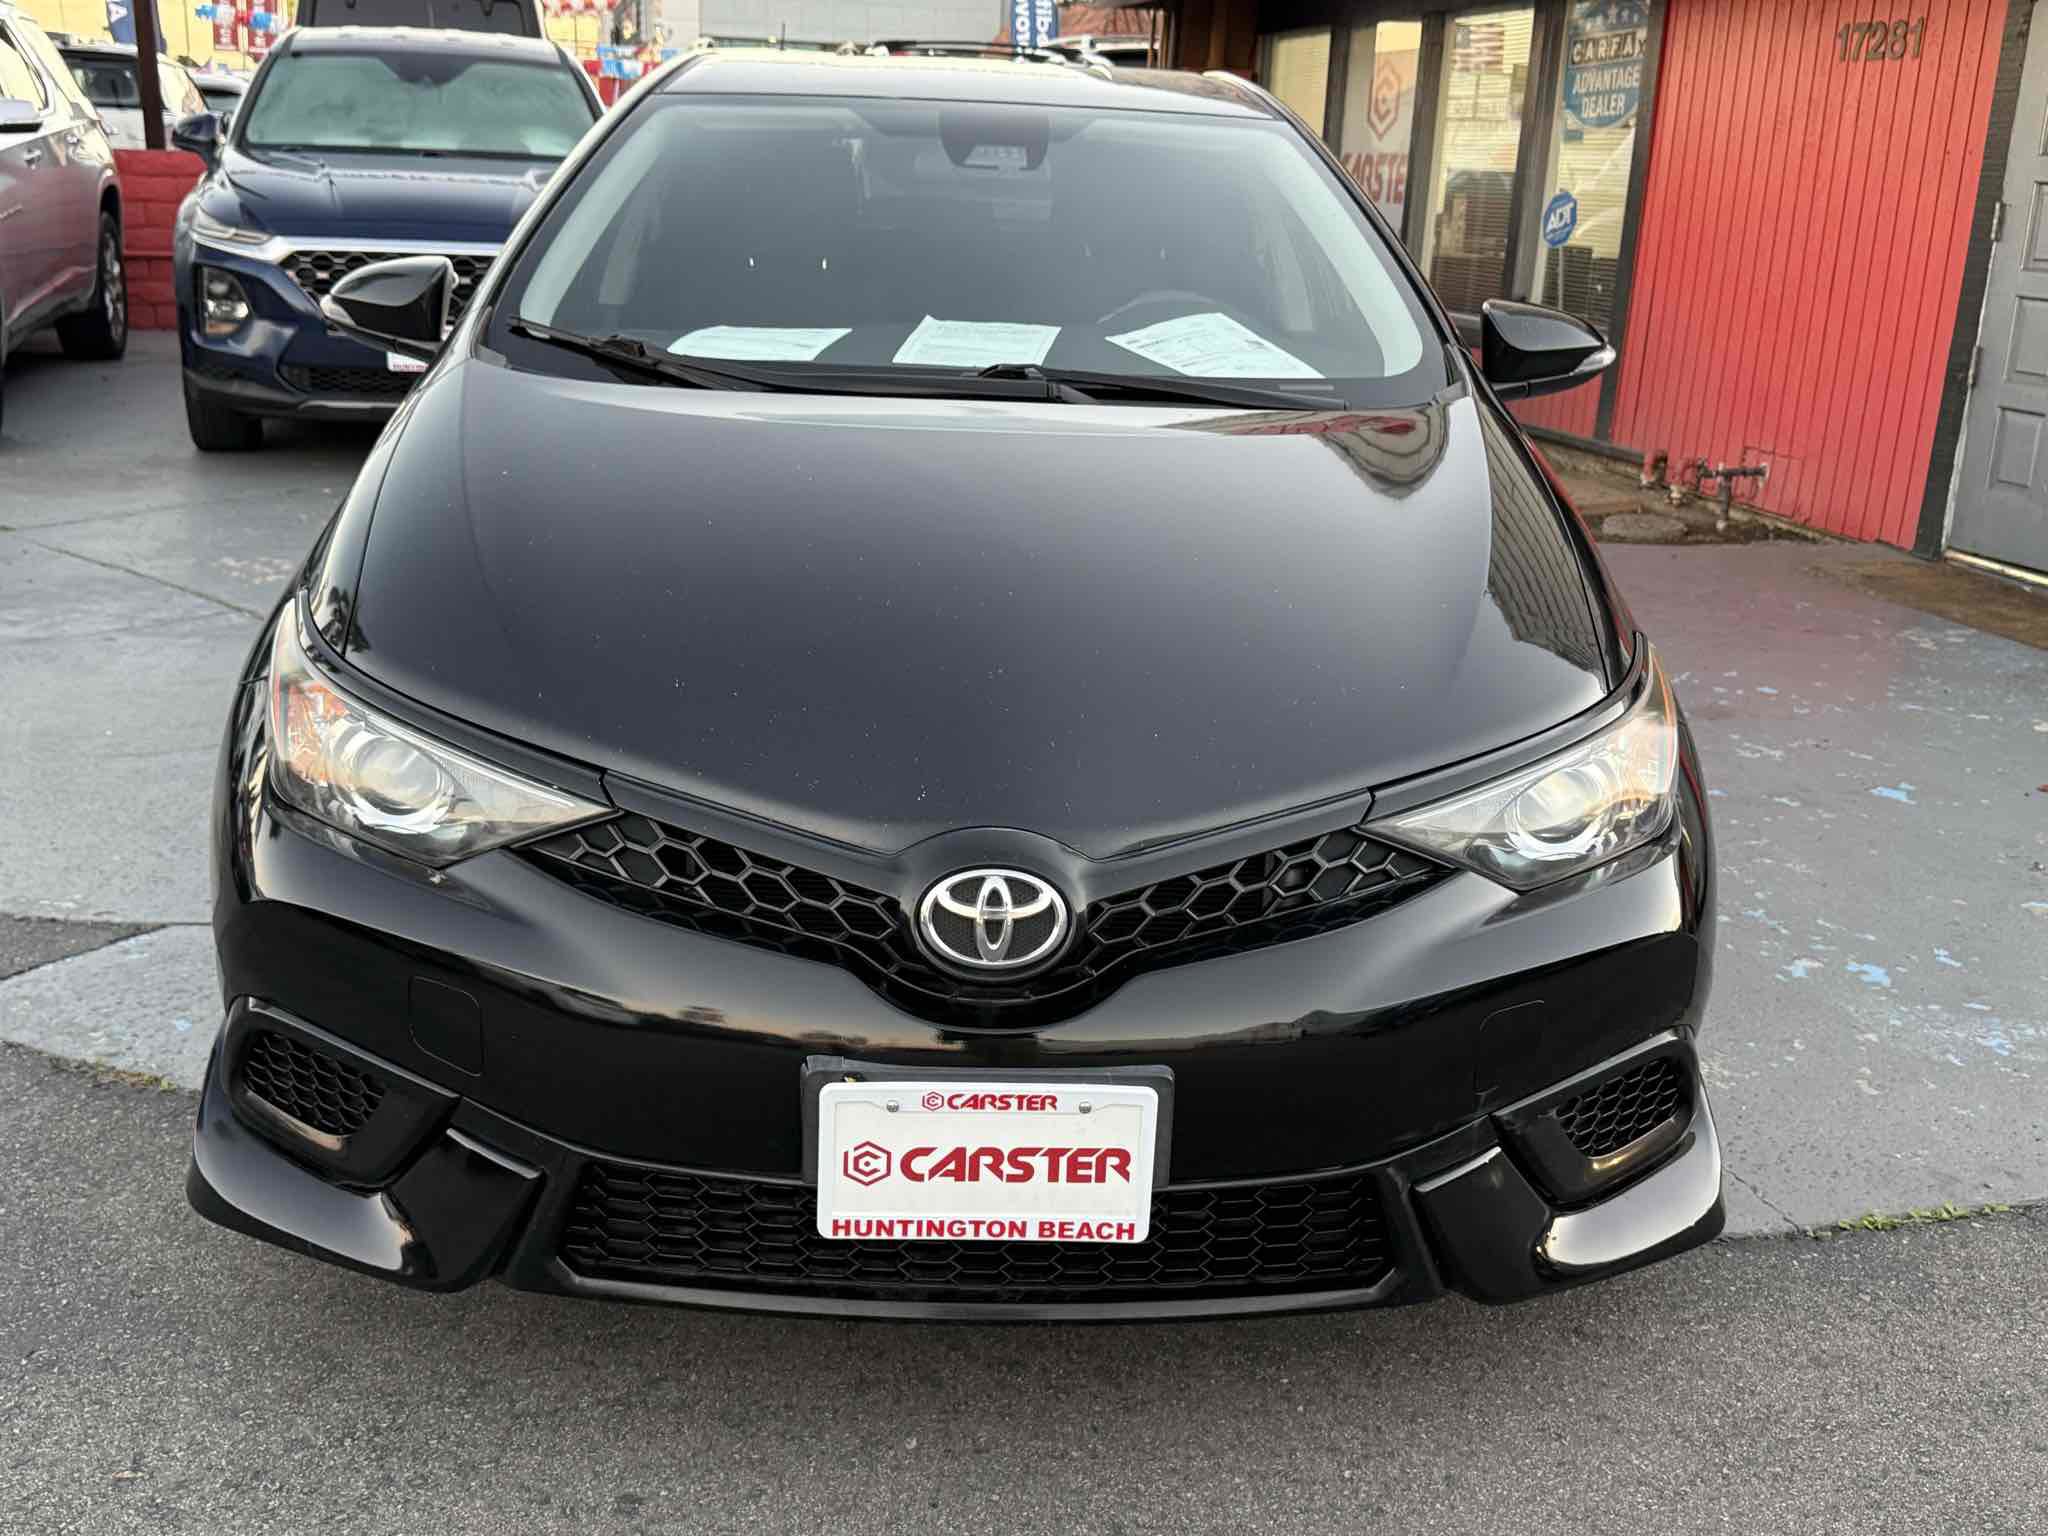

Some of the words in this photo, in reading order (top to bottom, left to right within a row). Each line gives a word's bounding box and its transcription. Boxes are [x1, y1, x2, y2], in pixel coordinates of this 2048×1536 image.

[1836, 16, 1925, 62] 17281
[1572, 64, 1641, 95] ADVANTAGE
[1583, 93, 1626, 118] DEALER
[1546, 203, 1575, 233] ADT
[947, 1093, 1058, 1111] CARSTER
[900, 1146, 1132, 1183] CARSTER
[832, 1218, 1029, 1238] HUNTINGTON
[1038, 1220, 1136, 1240] BEACH
